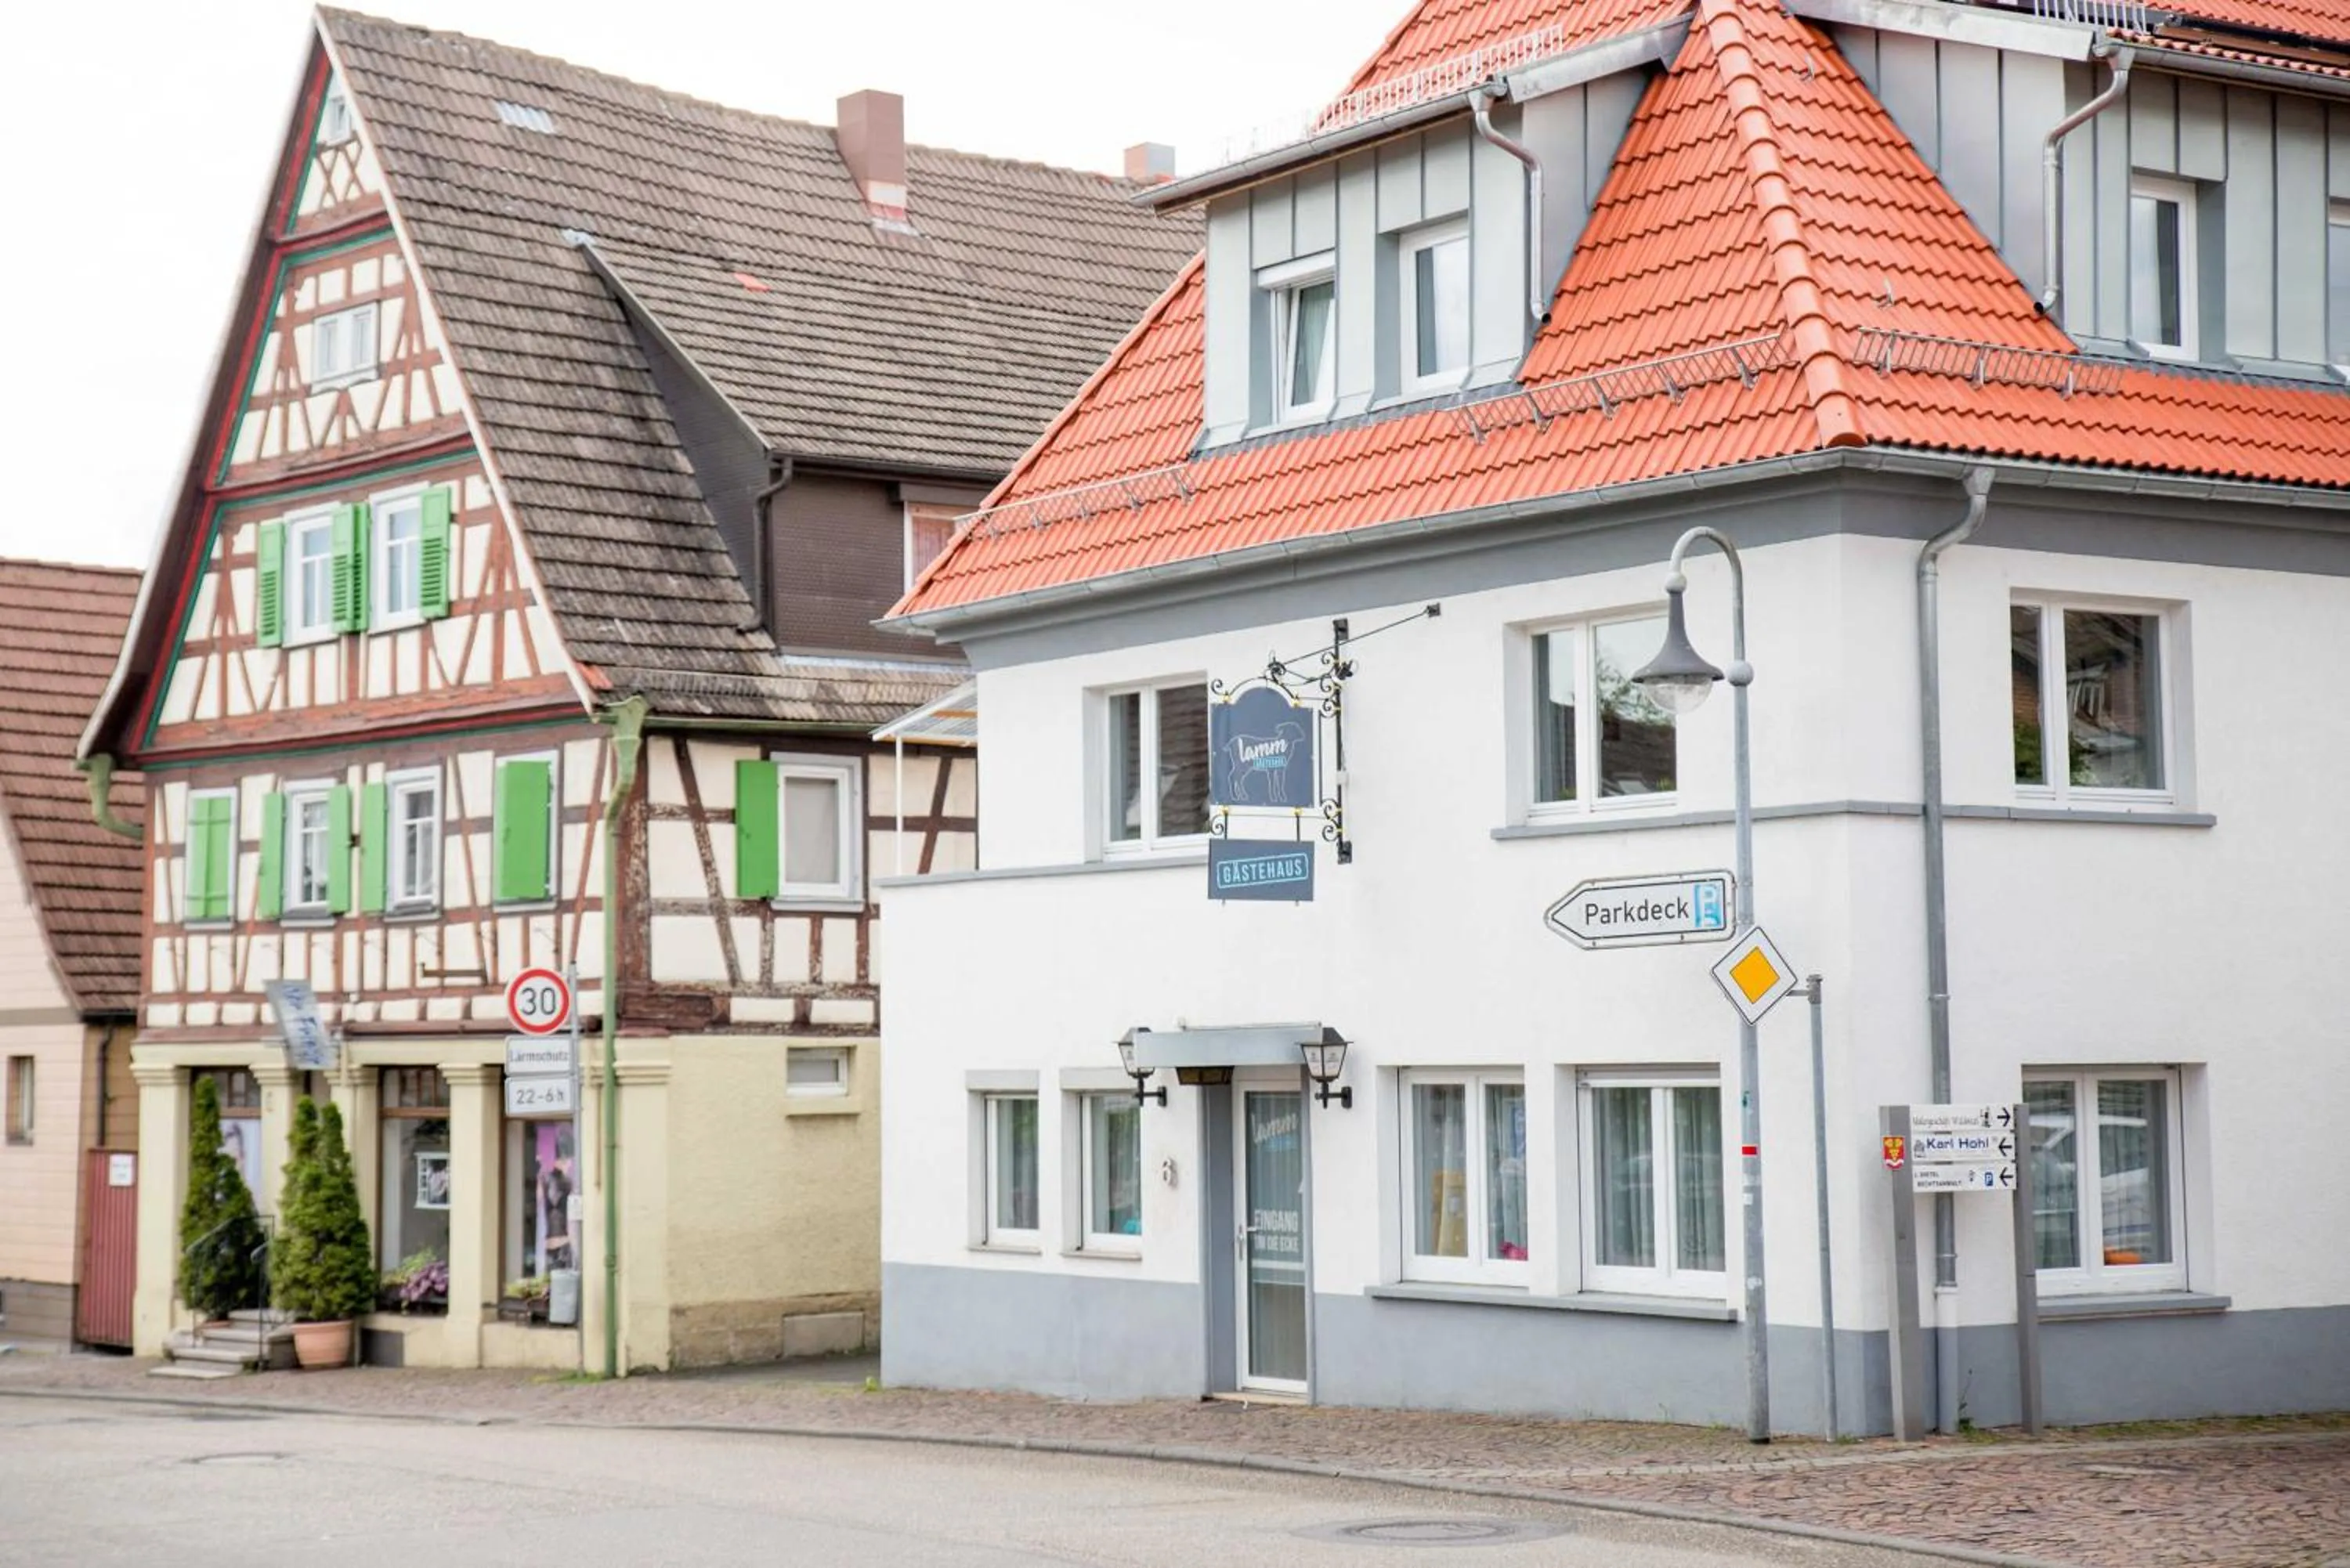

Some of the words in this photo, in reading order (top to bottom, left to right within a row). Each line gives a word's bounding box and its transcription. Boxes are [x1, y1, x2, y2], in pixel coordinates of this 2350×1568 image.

[1222, 858, 1302, 883] GÄSTEHAUS
[1585, 897, 1690, 925] Parkdeck
[521, 988, 557, 1016] 30
[1926, 1136, 1954, 1149] Karl
[1958, 1136, 1989, 1149] Hohl
[1254, 1209, 1298, 1233] EINGANG
